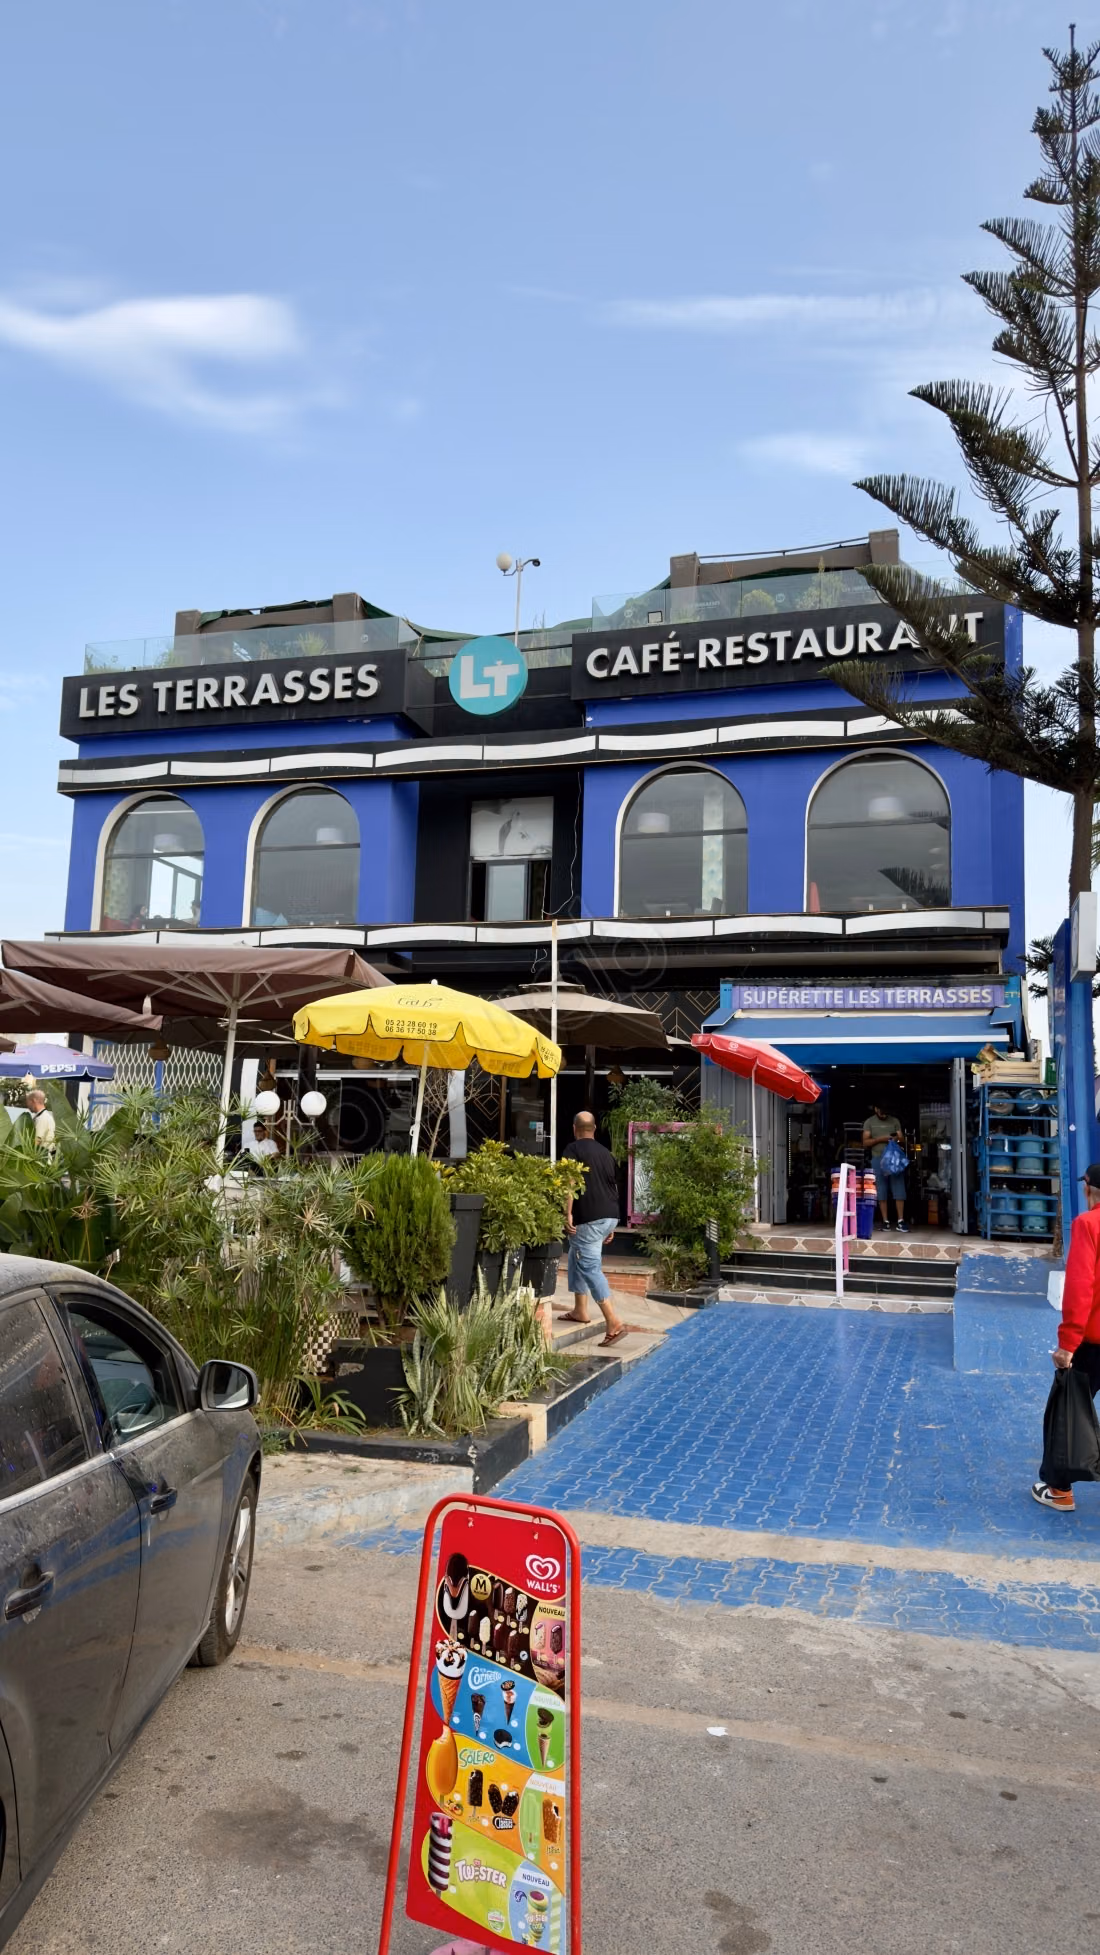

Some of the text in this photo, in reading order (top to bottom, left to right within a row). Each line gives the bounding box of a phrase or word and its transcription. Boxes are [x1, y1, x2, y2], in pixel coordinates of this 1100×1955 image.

[586, 611, 984, 678] CAFÉ-RESTAURAT
[79, 664, 381, 719] LES TERRASSES
[743, 987, 843, 1004] SUPÉRETTE
[849, 989, 880, 1004] LES
[884, 988, 992, 1004] TERRASSES
[385, 1018, 394, 1026] 05
[396, 1019, 405, 1027] 23
[407, 1020, 416, 1028] 28
[429, 1022, 438, 1030] 19
[385, 1025, 394, 1033] 06
[396, 1026, 405, 1034] 36
[417, 1027, 426, 1035] 50
[428, 1028, 437, 1036] 38
[41, 1063, 77, 1074] PEPSI
[526, 1578, 559, 1594] WALL'S
[468, 1666, 502, 1690] Cornetto
[522, 1873, 550, 1887] NOUVEAU
